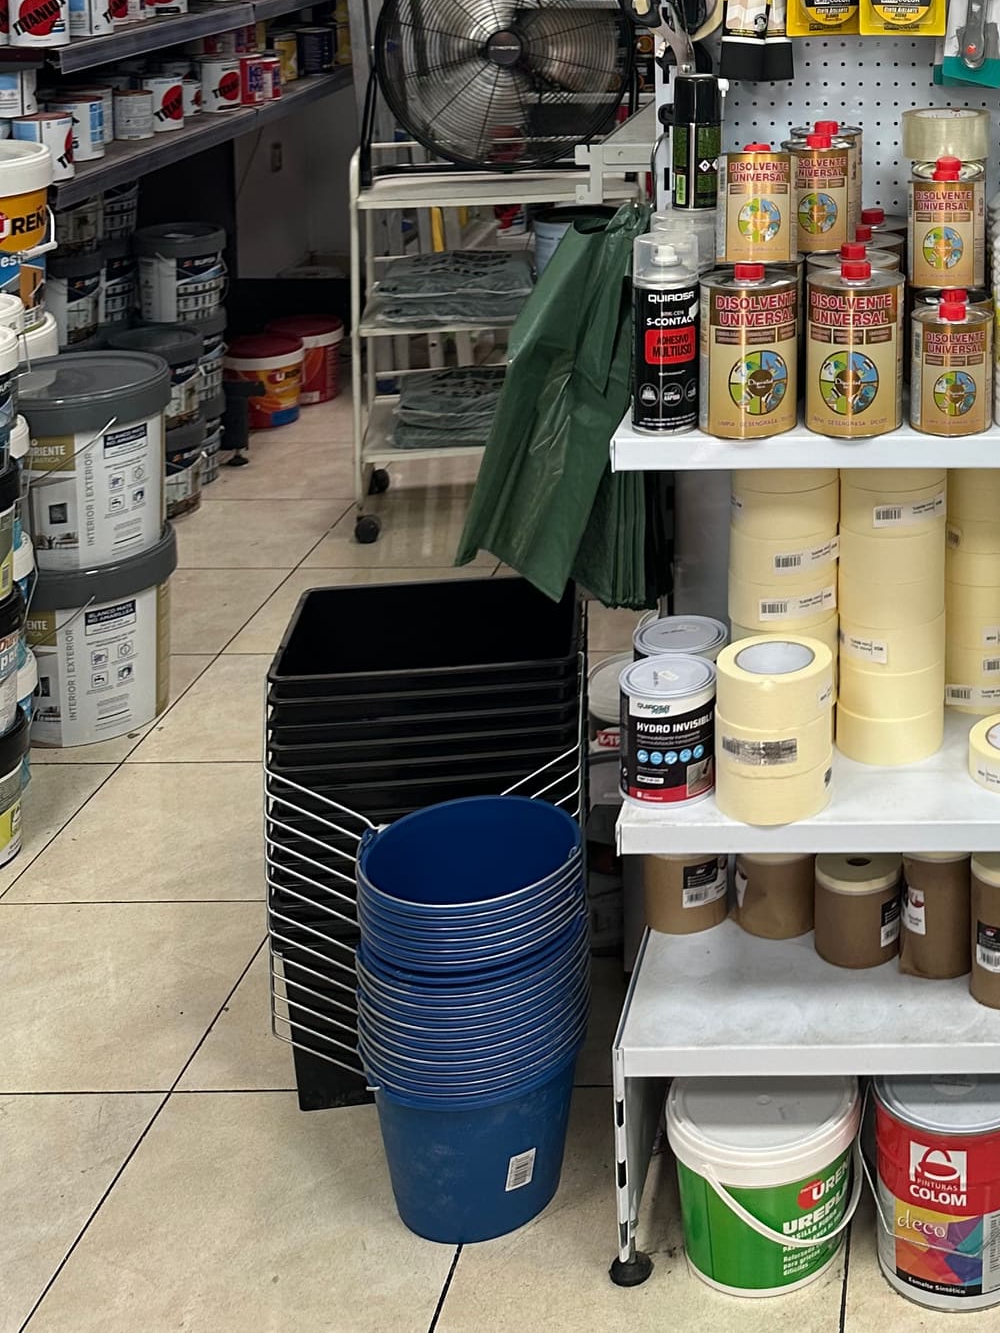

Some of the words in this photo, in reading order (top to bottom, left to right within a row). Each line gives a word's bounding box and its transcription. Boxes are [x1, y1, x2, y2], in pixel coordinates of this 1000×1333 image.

[729, 161, 789, 172] DISOLVENTE
[733, 172, 786, 182] UNIVERSAL
[915, 190, 972, 200] DISOLVENTE
[918, 202, 969, 211] UNIVERSAL
[715, 290, 797, 310] DISOLVENTE
[811, 292, 892, 310] DISOLVENTE
[720, 311, 795, 326] UNIVERSAL
[813, 312, 889, 326] UNIVERSAL
[656, 334, 689, 346] ADHESIVO
[926, 331, 985, 343] DISOLVENTE
[652, 344, 692, 357] MULTIUSO
[928, 343, 983, 354] UNIVERSAL
[85, 452, 94, 496] EXTERIOR
[86, 498, 96, 547] INTERIOR
[637, 722, 671, 734] HYDRO
[917, 1178, 958, 1192] PINTURAS
[909, 1185, 967, 1206] COLOM
[897, 1210, 947, 1239] deco
[908, 1277, 934, 1290] Esmalte
